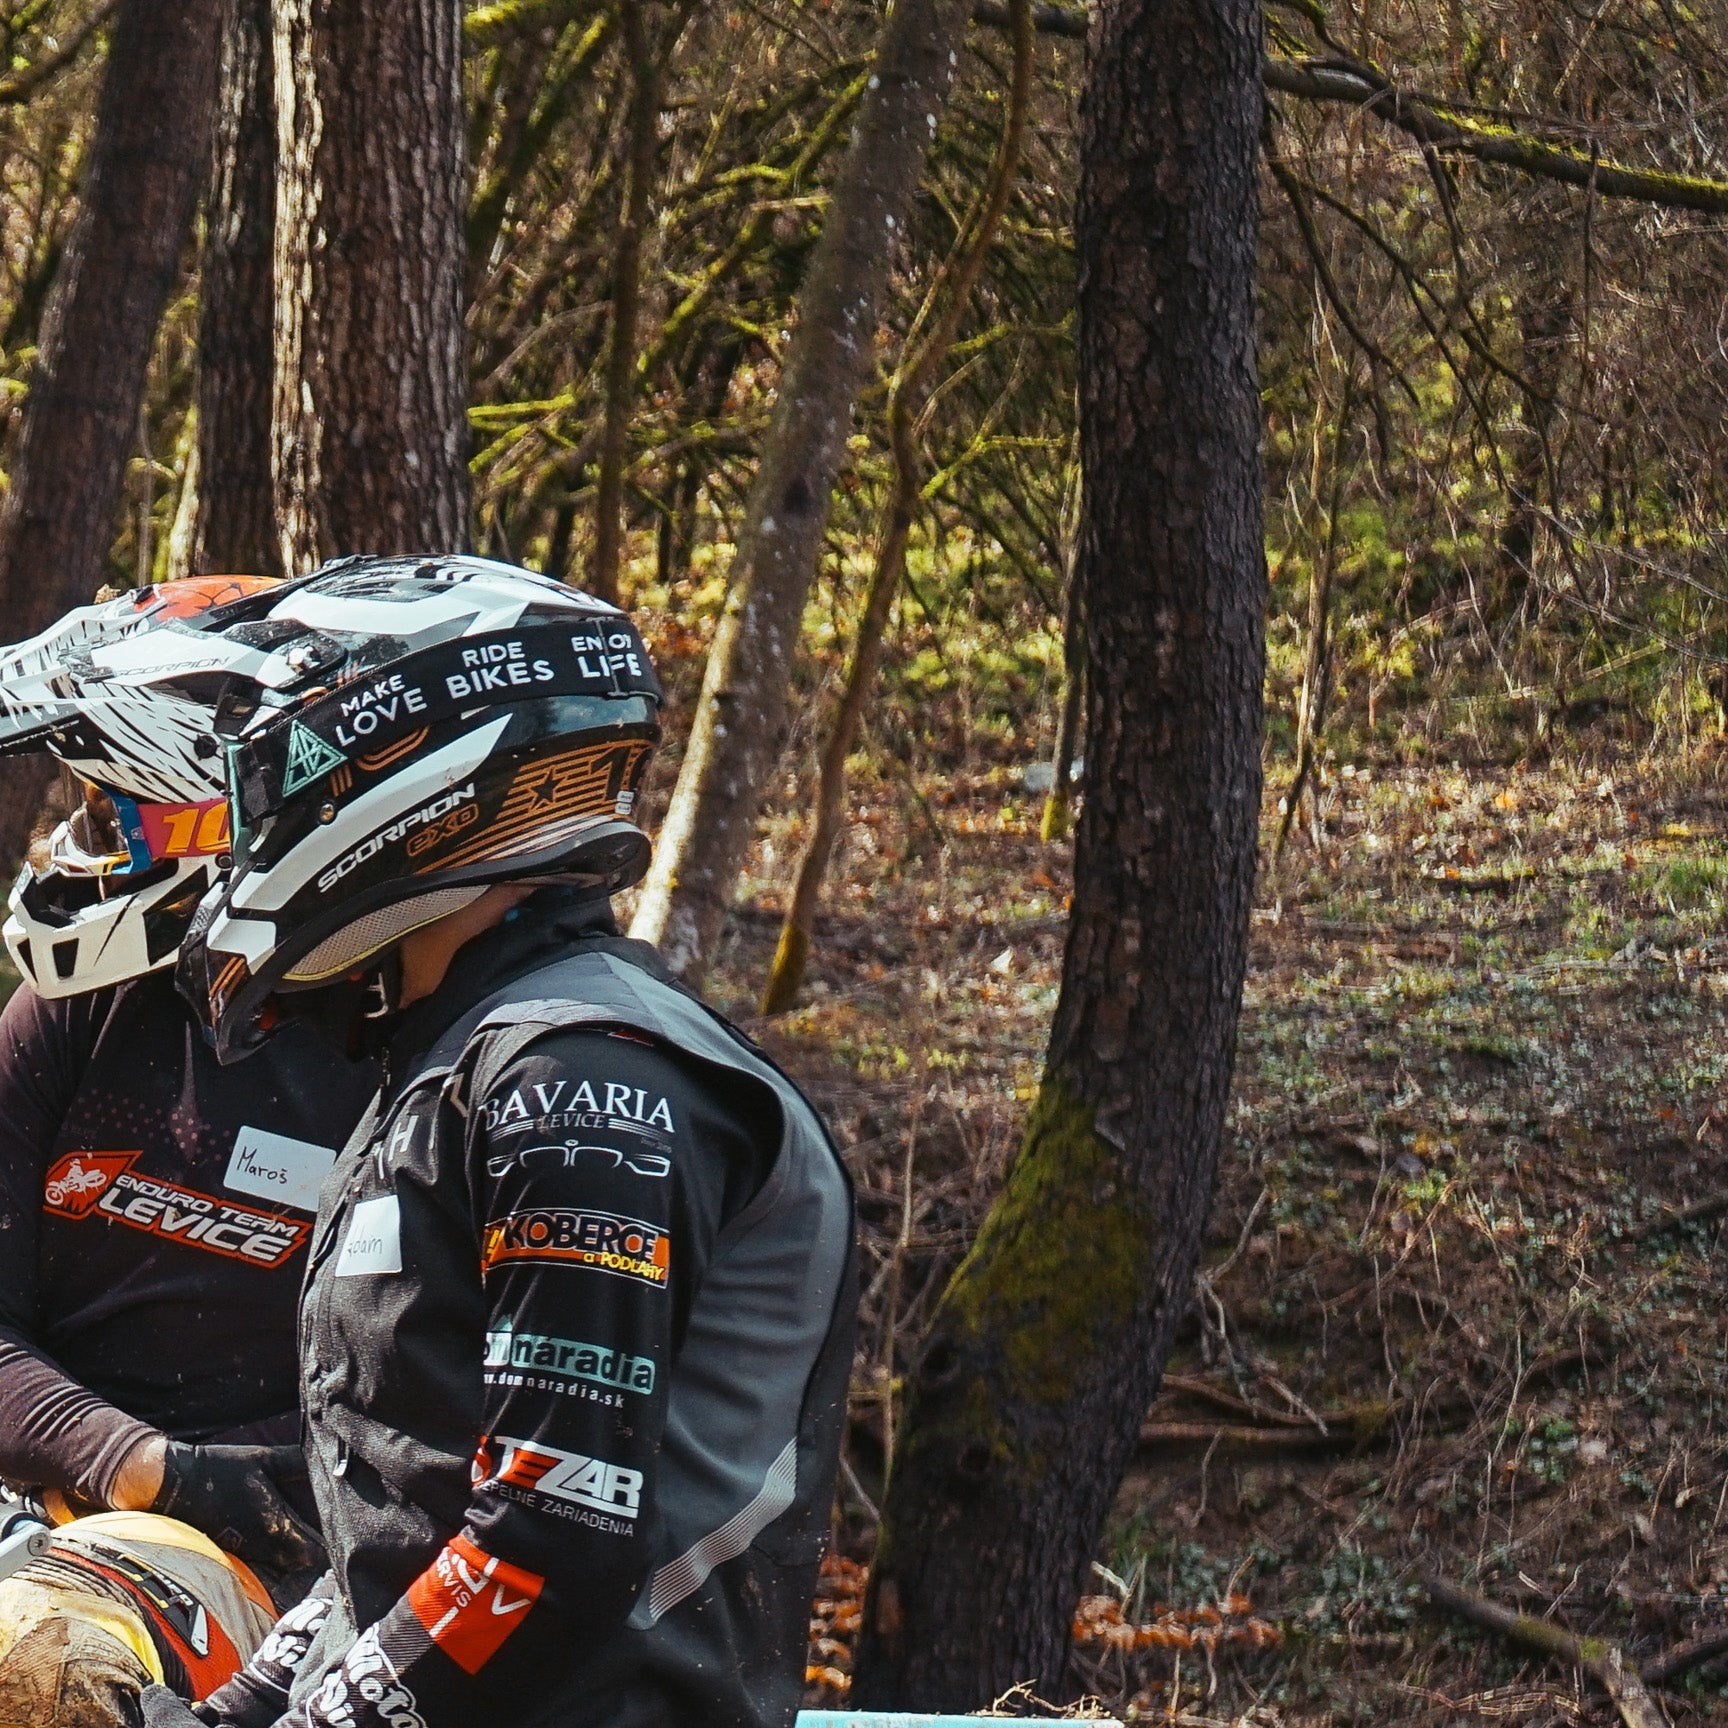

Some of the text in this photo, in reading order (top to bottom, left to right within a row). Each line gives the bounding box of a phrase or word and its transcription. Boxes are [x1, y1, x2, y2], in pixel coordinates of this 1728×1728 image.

[461, 641, 526, 667] RIDE
[577, 653, 642, 678] LIFE
[340, 674, 405, 717] MAKE
[445, 659, 554, 700] BIKES
[335, 687, 428, 747] LOVE
[317, 782, 476, 894] SCORPION
[481, 1079, 676, 1134] BAVARIA
[235, 1146, 288, 1185] Maroš
[98, 1187, 293, 1263] LEVICE
[114, 1174, 300, 1238] ENDURO TEAM
[505, 1211, 660, 1266] KOBERCE
[600, 1251, 665, 1281] PODLAHY
[494, 1436, 644, 1512] TEZAR
[541, 1498, 635, 1537] ZARIADENIA
